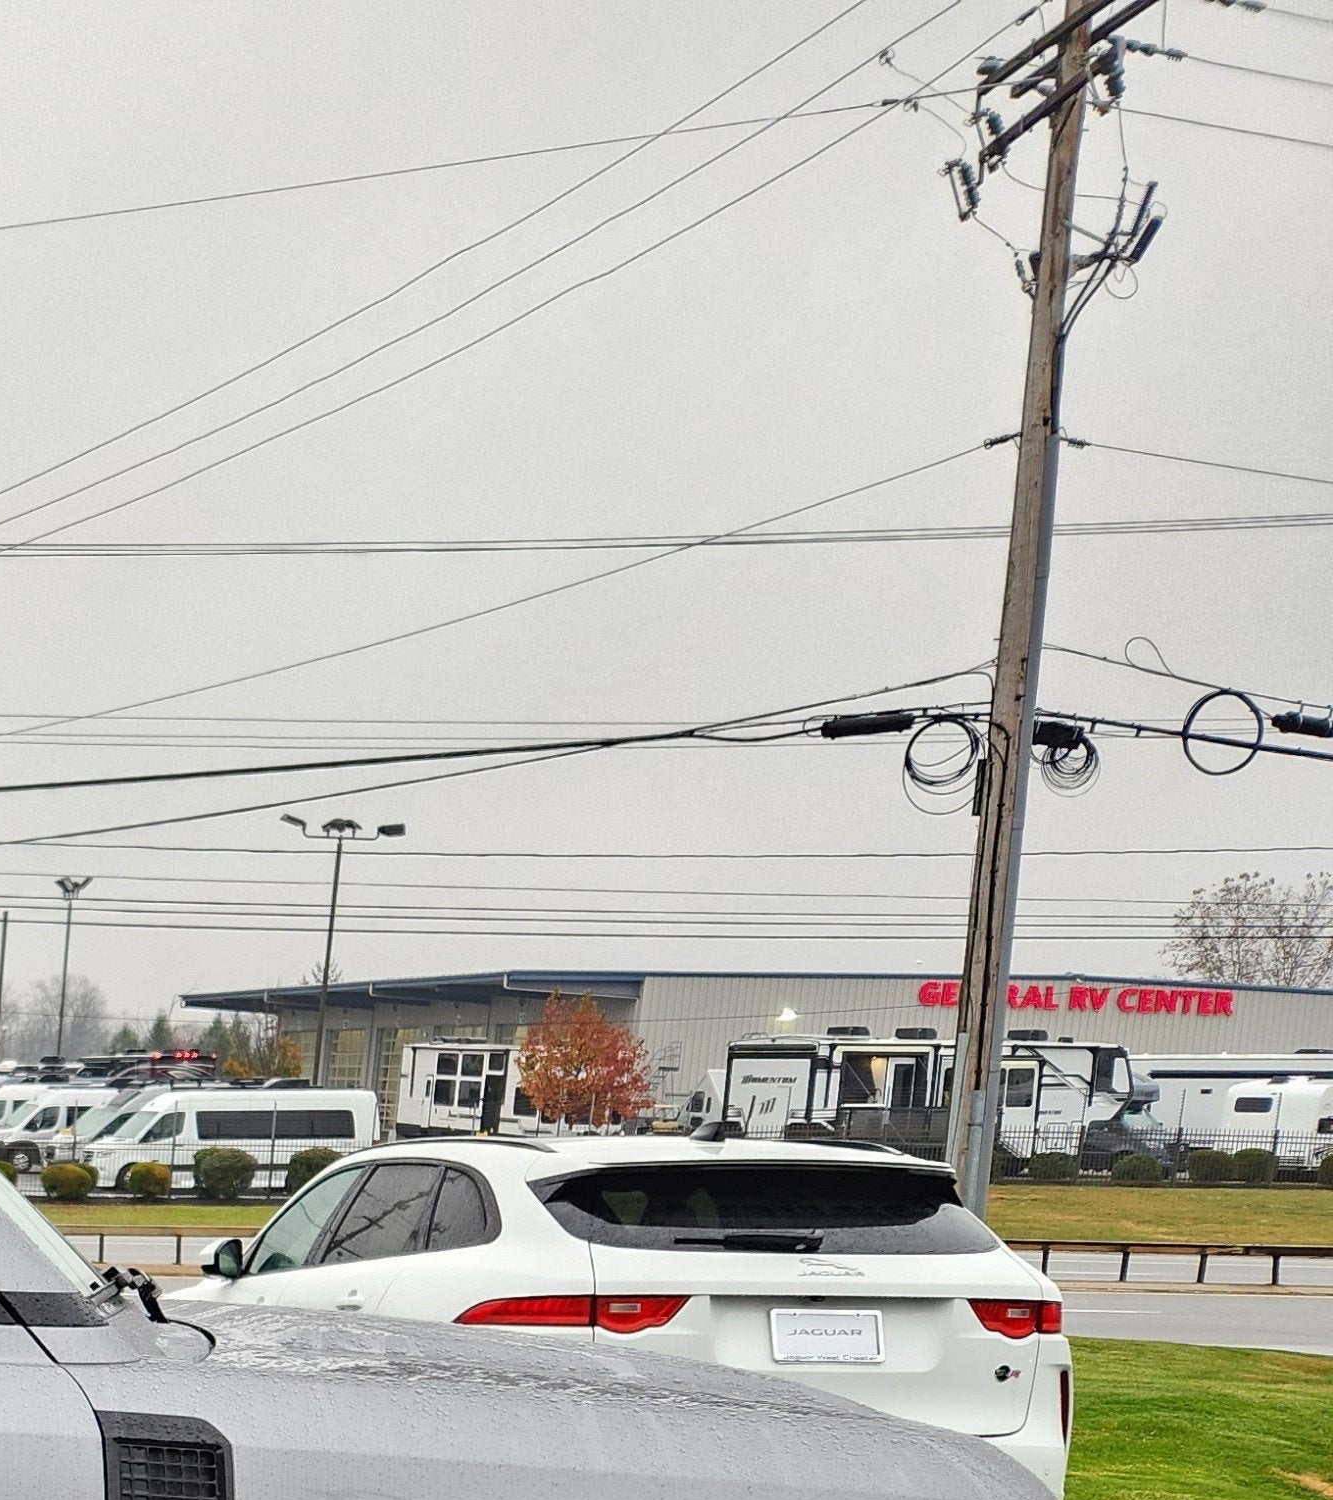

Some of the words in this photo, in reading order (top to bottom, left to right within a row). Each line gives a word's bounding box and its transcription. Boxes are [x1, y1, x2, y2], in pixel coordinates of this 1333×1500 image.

[919, 981, 1059, 1011] GERAL
[1068, 986, 1111, 1012] RV
[1117, 988, 1235, 1016] CENTER
[786, 1328, 863, 1336] JAGUAR
